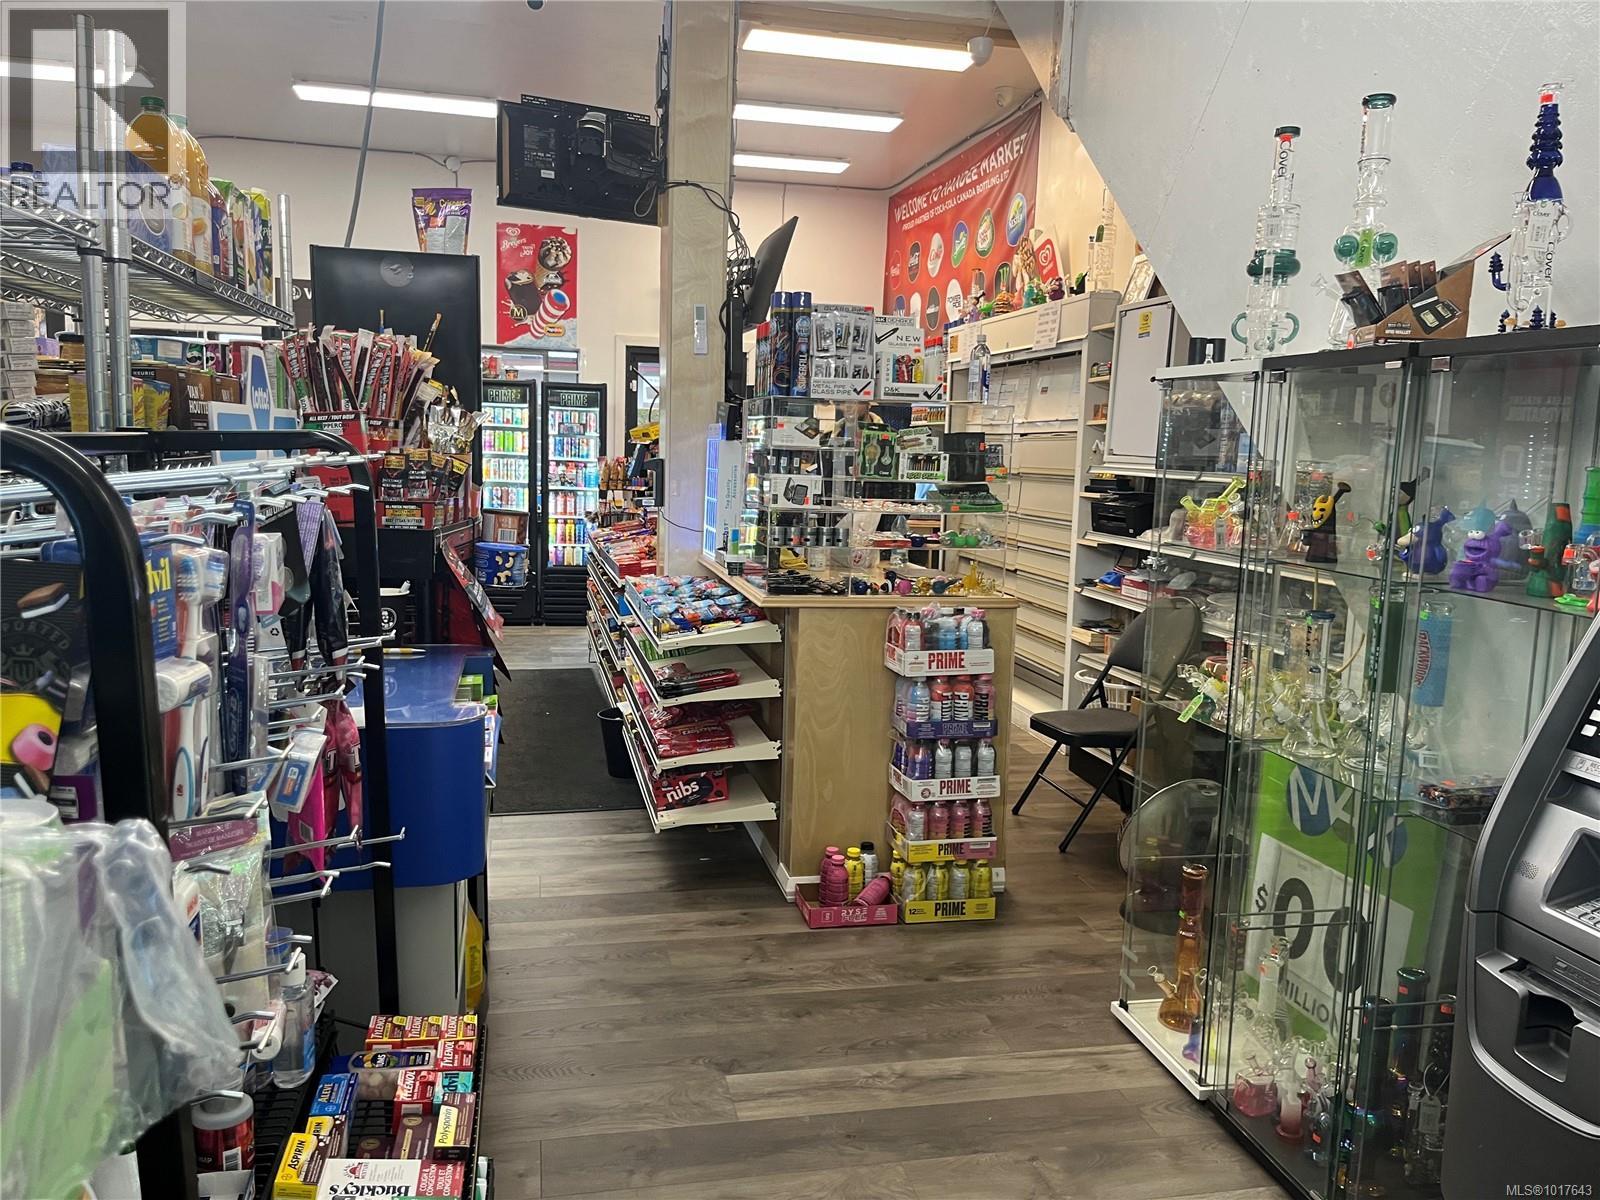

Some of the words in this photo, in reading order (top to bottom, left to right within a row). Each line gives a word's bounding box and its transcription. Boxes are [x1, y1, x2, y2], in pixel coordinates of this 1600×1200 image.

[894, 192, 929, 222] WELCOME
[930, 184, 942, 204] TO
[980, 133, 1027, 177] MARKET
[935, 198, 957, 215] COCA-COLA
[957, 187, 976, 203] CANADA
[976, 178, 999, 195] BOTTLING
[502, 238, 527, 251] Breyers
[187, 385, 199, 399] VAN
[560, 393, 588, 406] PRIME
[928, 651, 965, 669] PRIME
[666, 780, 700, 803] nibs
[940, 779, 971, 795] PRIME
[938, 843, 965, 856] PRIME
[841, 908, 868, 916] RYSE
[934, 901, 966, 916] PRIME
[371, 1016, 386, 1038] TYLENOL
[408, 1016, 423, 1038] TYLENOL
[445, 1015, 458, 1038] TYLENOL
[440, 1041, 455, 1067] TYLENOL
[319, 1083, 333, 1103] ALEVE
[401, 1070, 416, 1101] TYLENOL
[439, 1108, 453, 1144] Polysporin
[288, 1140, 306, 1170] ASPIRIN
[420, 1172, 428, 1191] COUGH
[426, 1163, 437, 1196] CONGESTION
[437, 1175, 445, 1190] TOUX
[443, 1163, 454, 1196] CONGESTION
